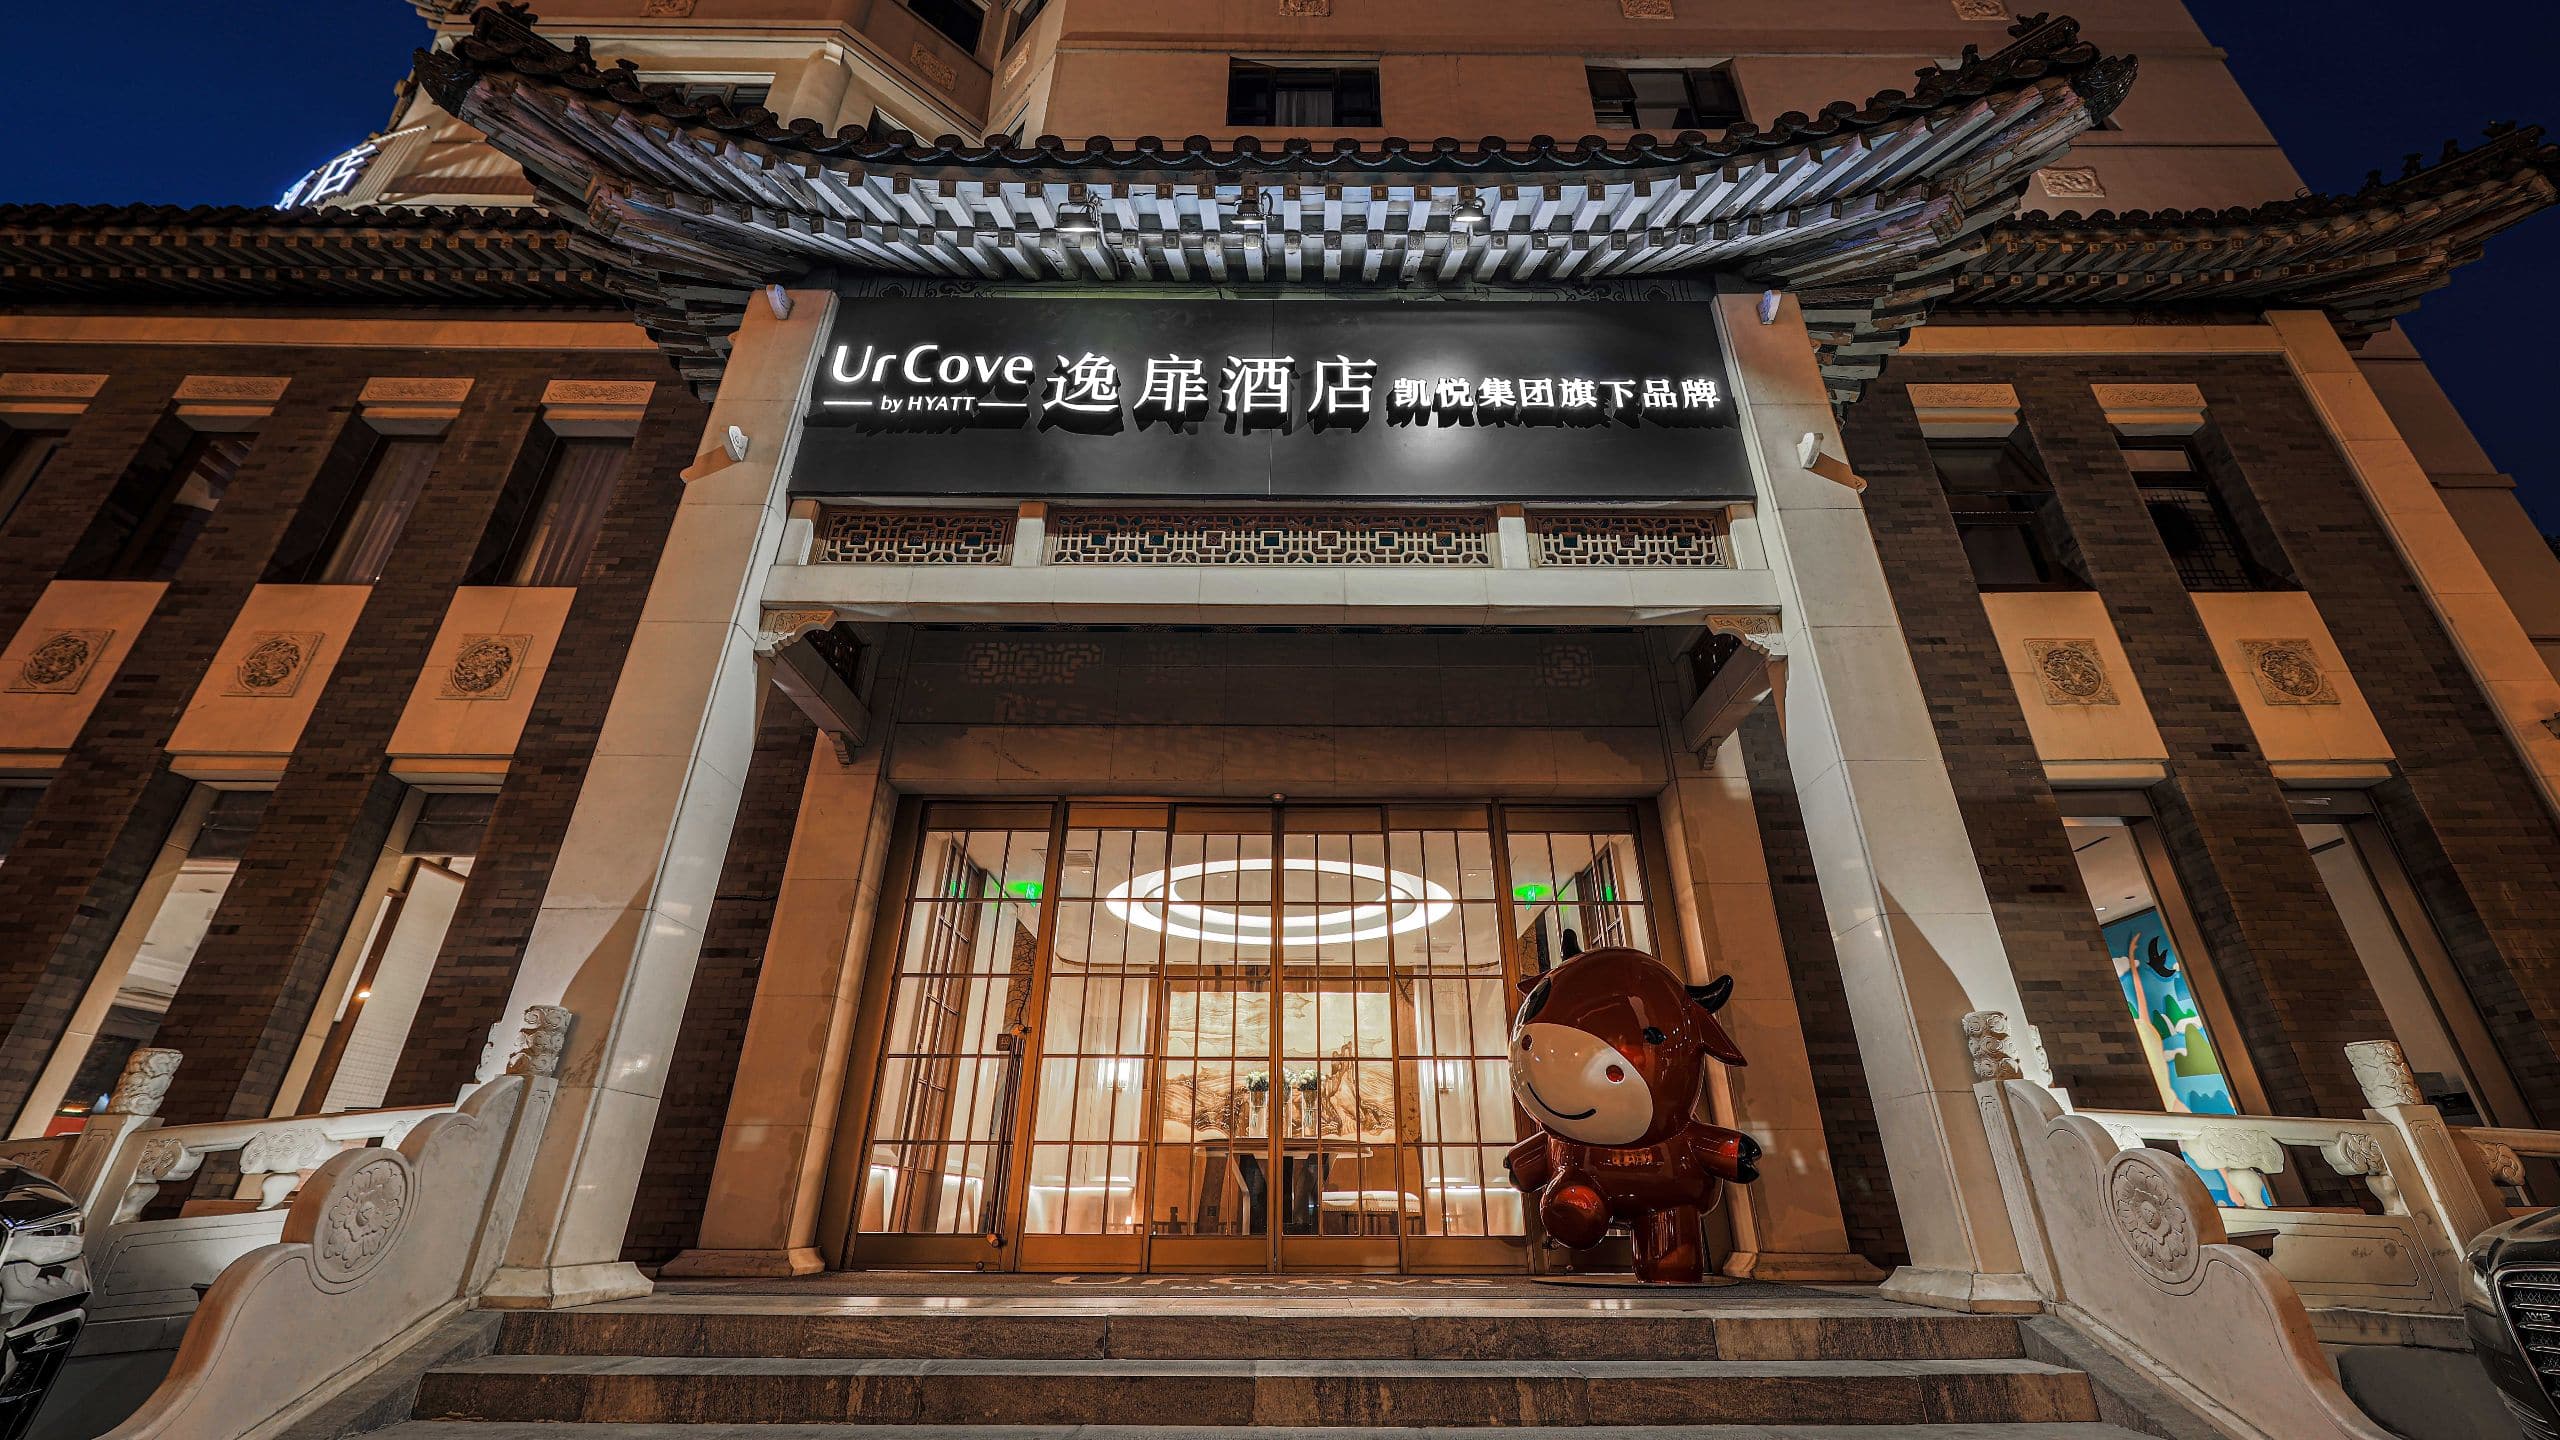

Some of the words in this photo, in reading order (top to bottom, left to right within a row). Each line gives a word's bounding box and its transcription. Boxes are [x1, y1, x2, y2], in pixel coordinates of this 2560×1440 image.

[1041, 351, 1378, 413] 逸扉酒店
[1393, 377, 1722, 410] 凯悦集团旗下品牌
[880, 395, 903, 414] by
[907, 396, 976, 411] HYATT
